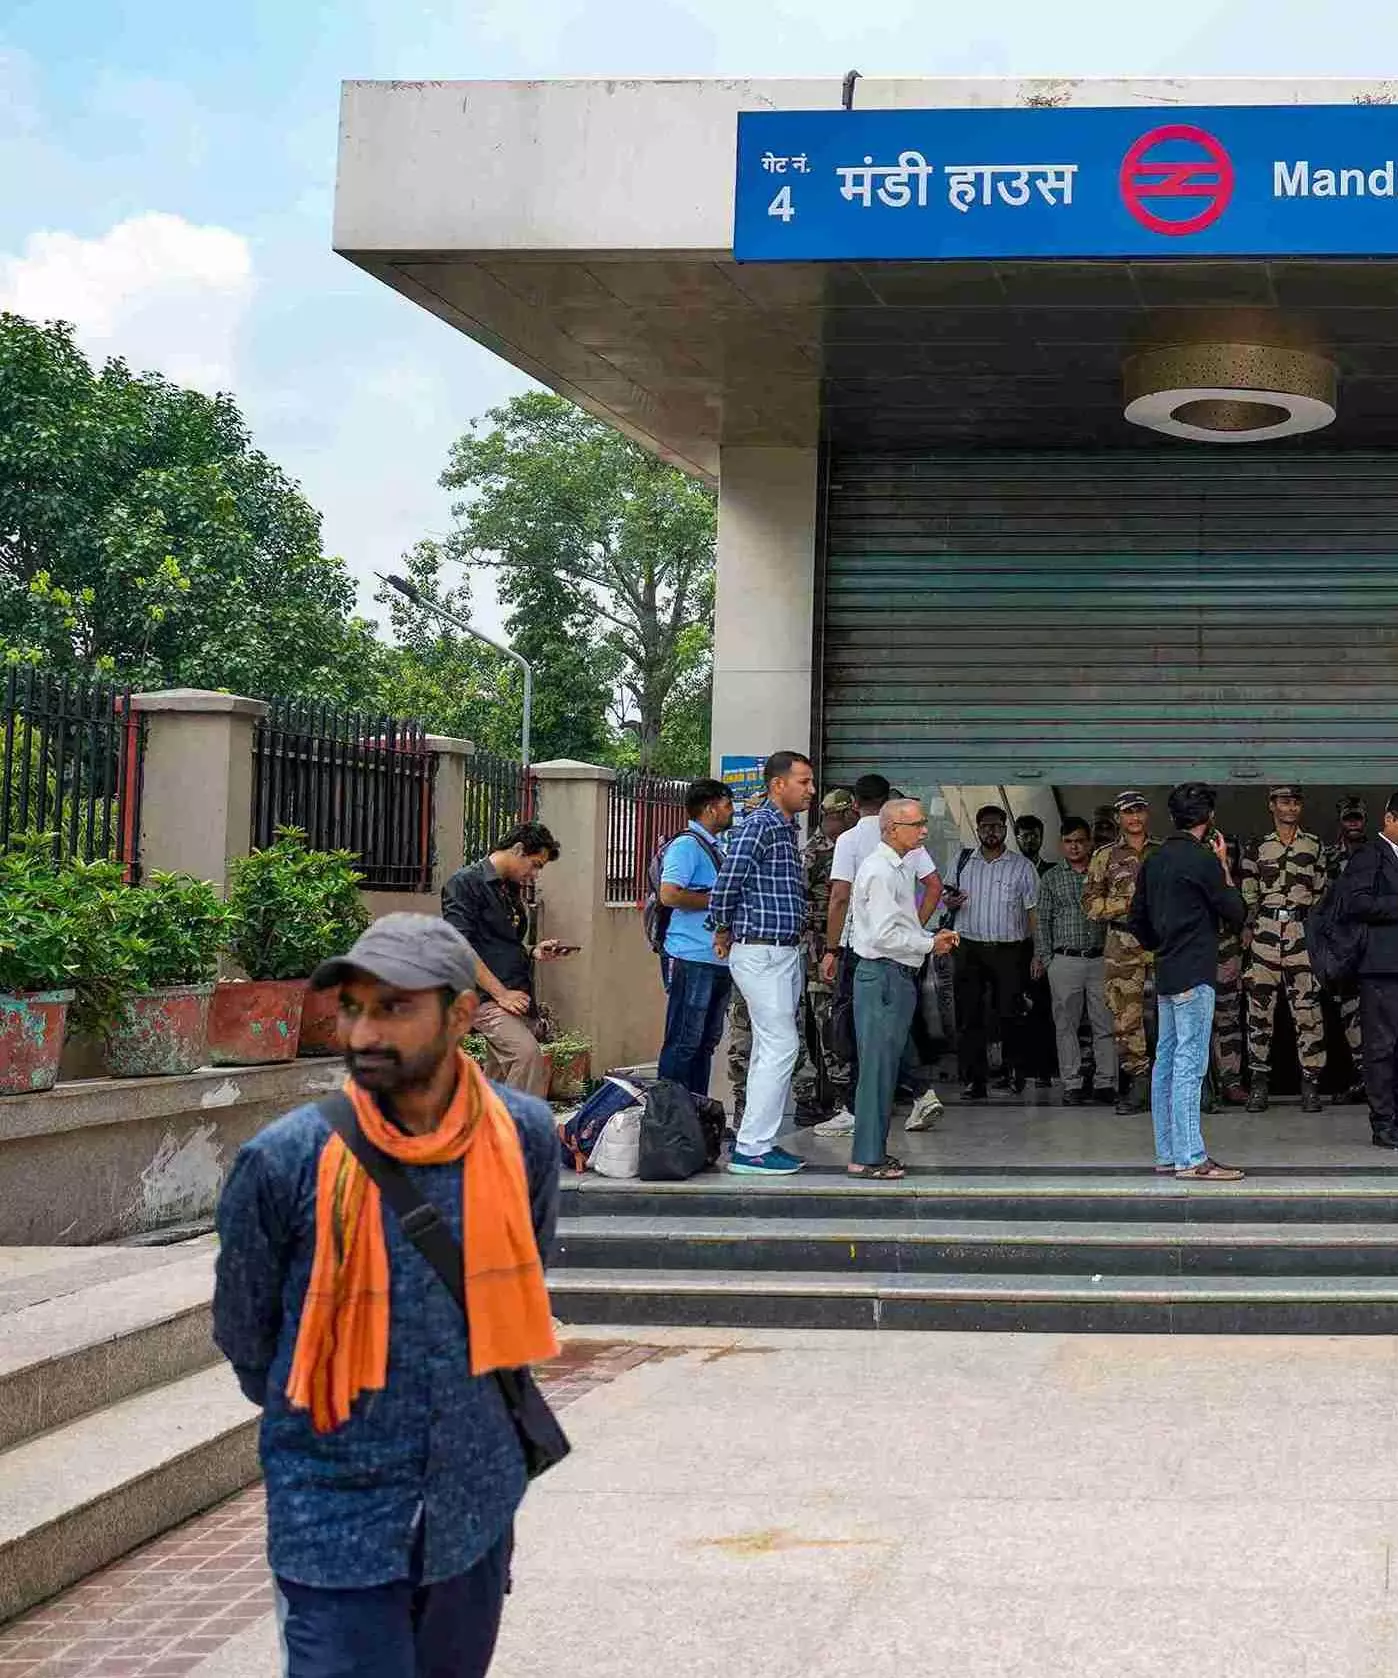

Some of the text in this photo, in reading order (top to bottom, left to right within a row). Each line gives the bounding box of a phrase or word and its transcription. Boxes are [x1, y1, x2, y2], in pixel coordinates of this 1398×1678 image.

[761, 152, 811, 173] गेट नं.
[836, 151, 1078, 213] मंडी हाउस
[767, 186, 795, 222] 4
